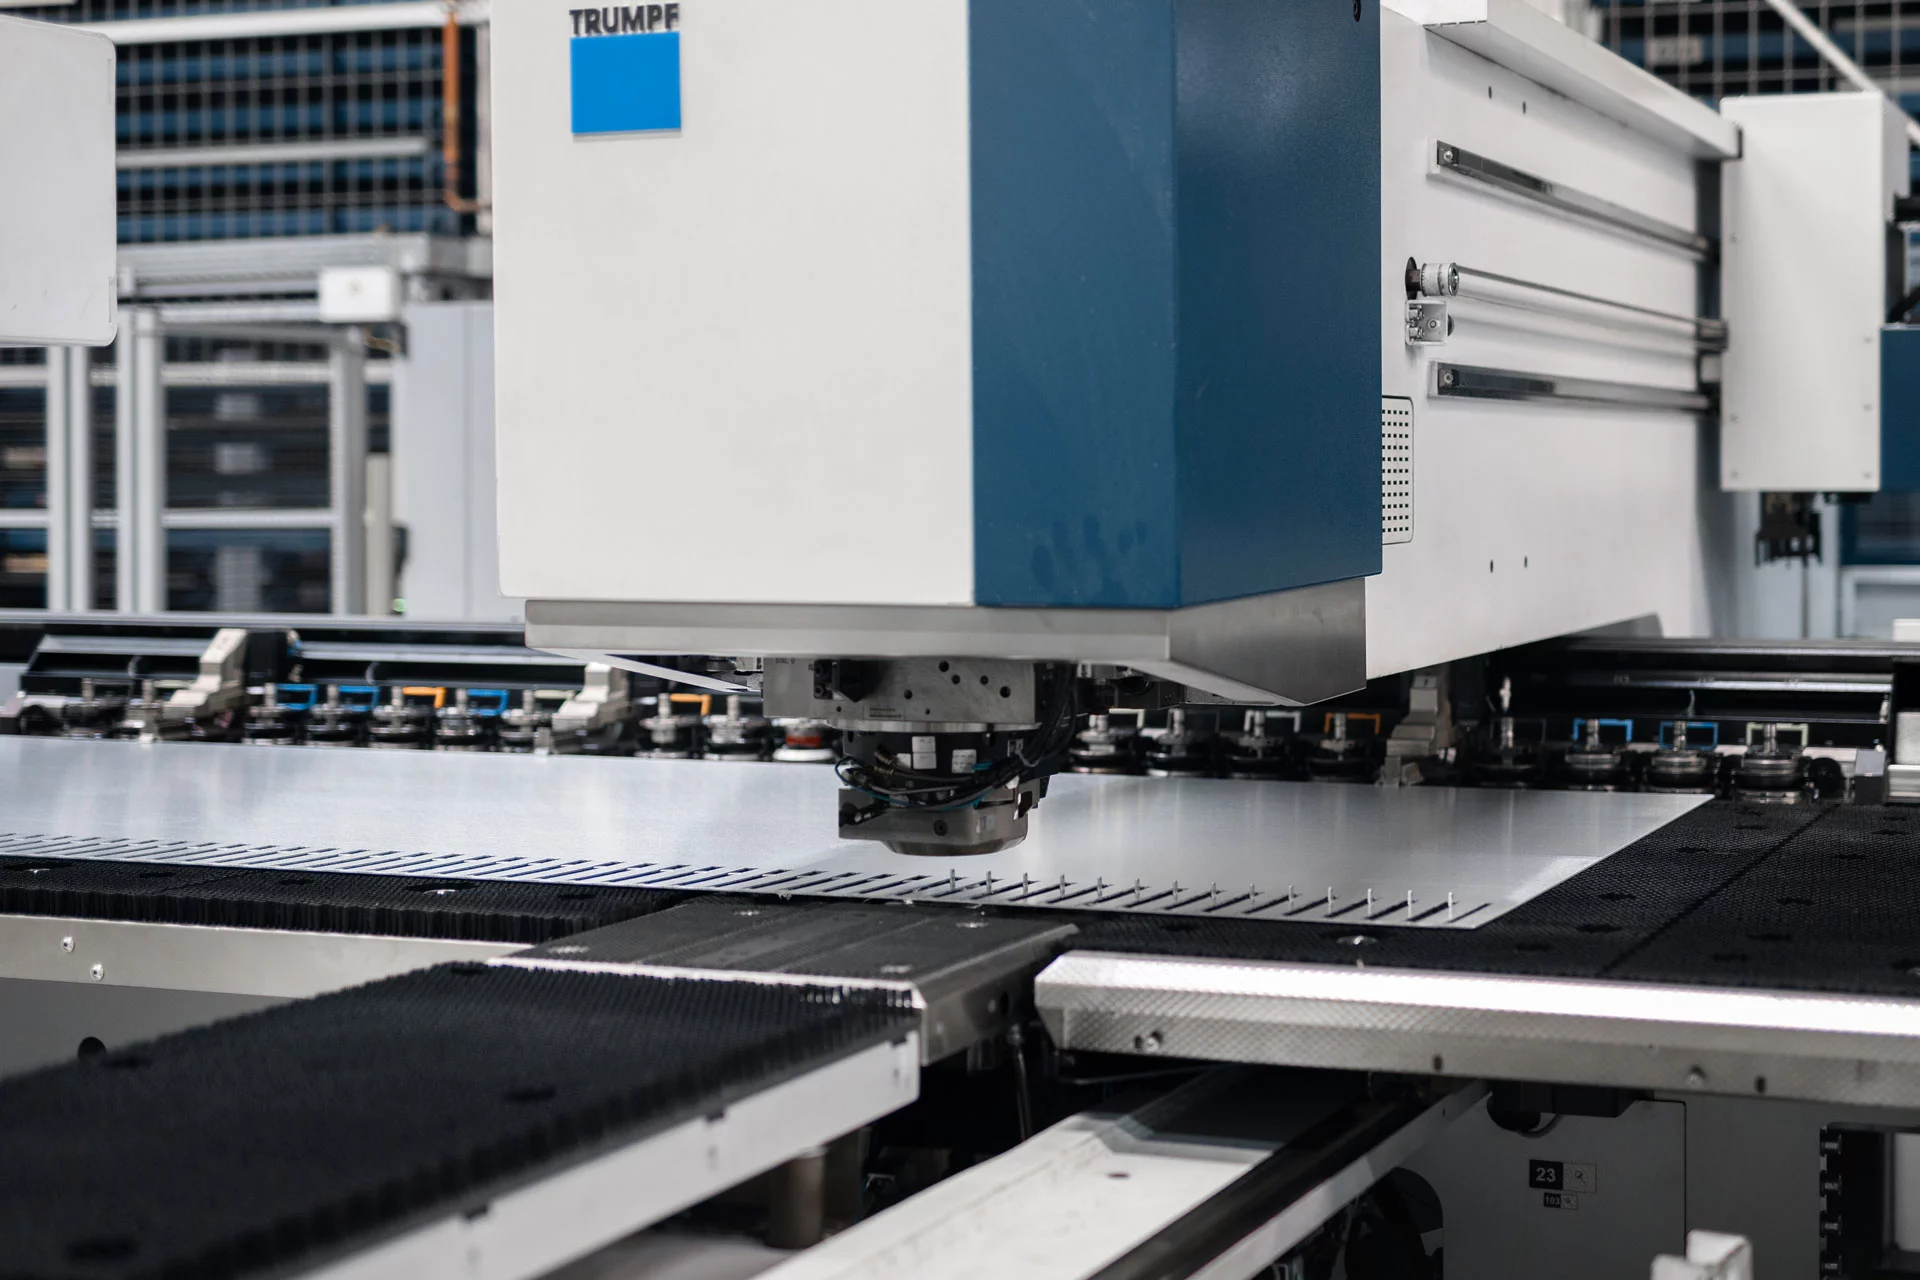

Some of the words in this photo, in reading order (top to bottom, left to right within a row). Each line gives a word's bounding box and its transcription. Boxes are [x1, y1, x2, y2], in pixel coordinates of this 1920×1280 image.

[569, 3, 680, 35] TRUMPF
[1535, 1167, 1556, 1183] 23
[1545, 1196, 1561, 1205] 103
